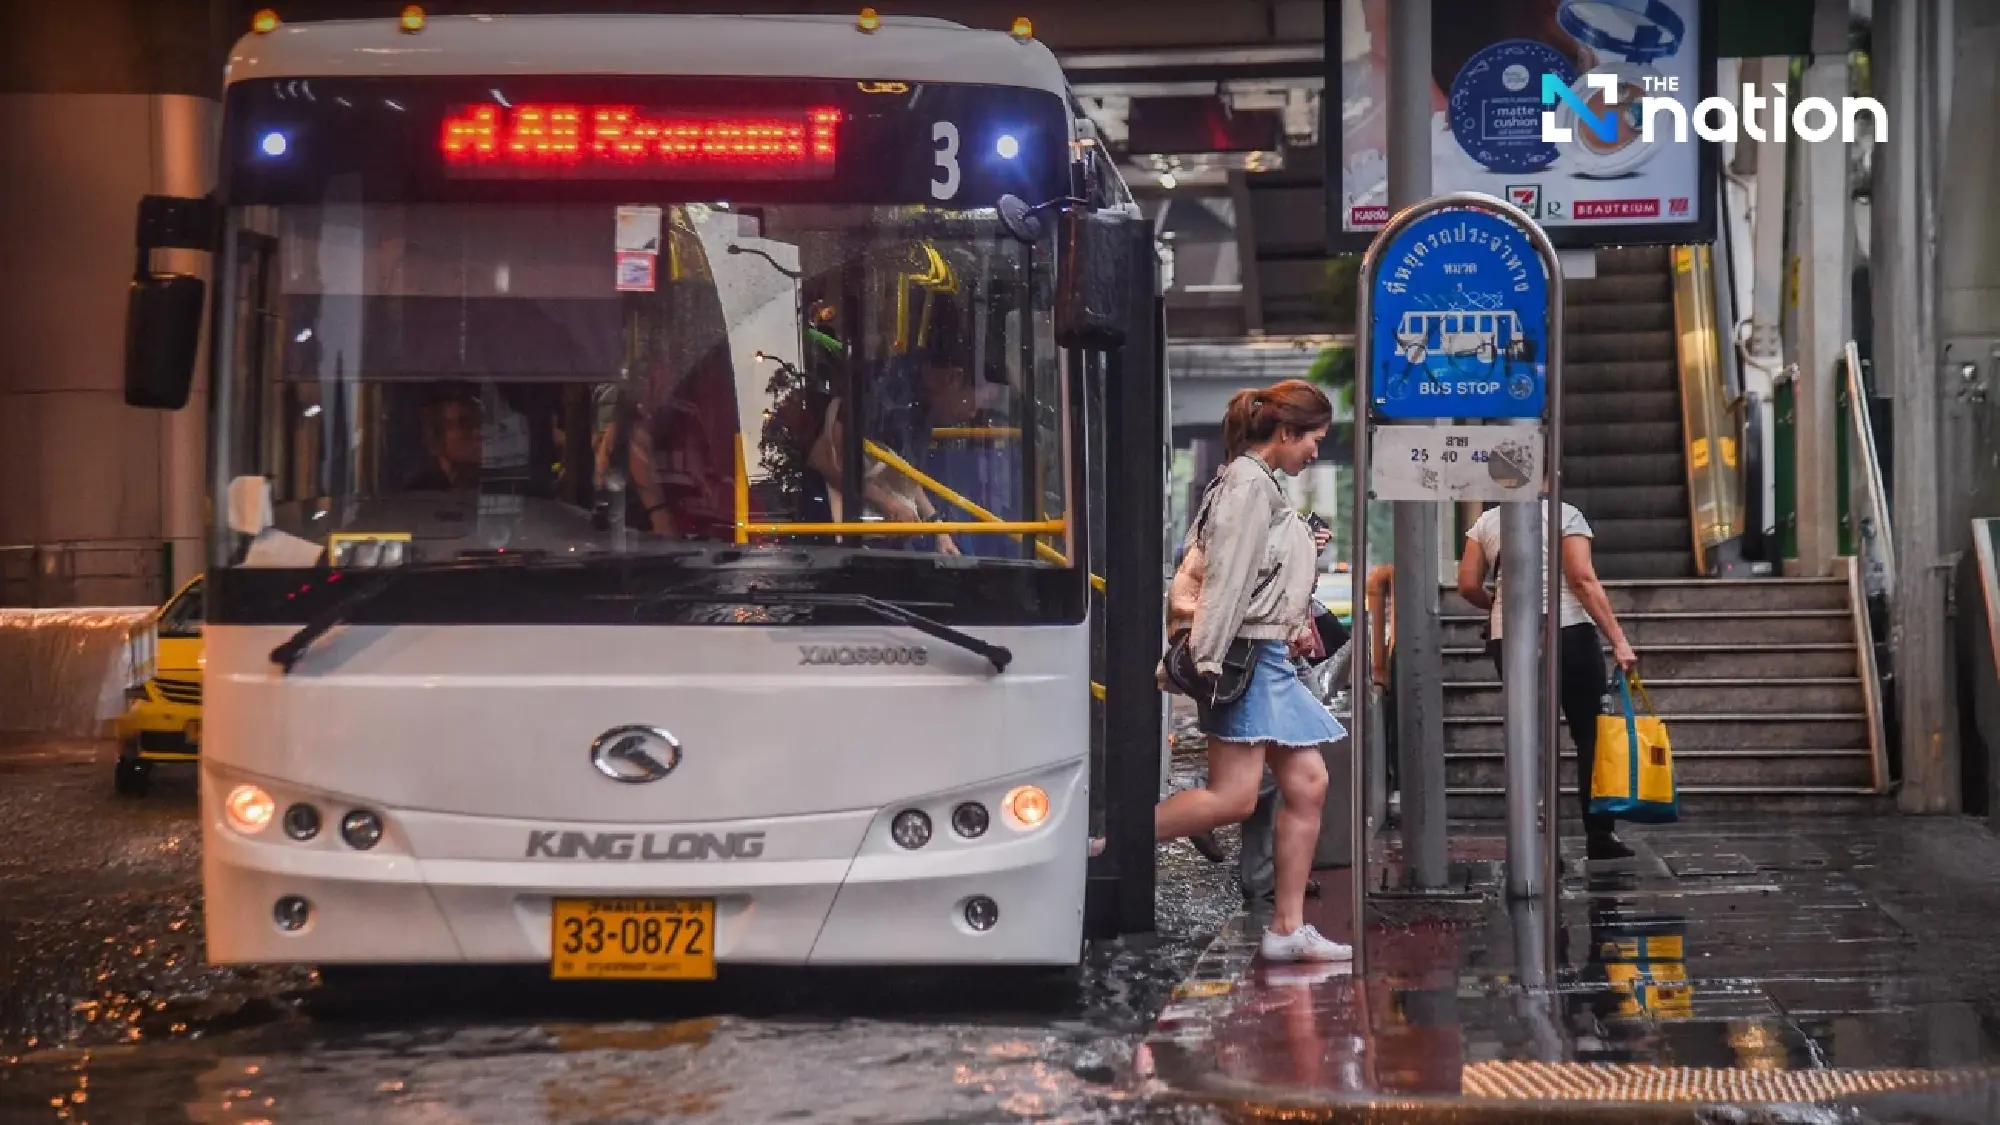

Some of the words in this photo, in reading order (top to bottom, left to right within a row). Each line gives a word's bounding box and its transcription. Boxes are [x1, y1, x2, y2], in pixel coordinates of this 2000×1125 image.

[1496, 105, 1536, 117] matte
[1493, 116, 1539, 129] cushion
[930, 121, 961, 201] 3
[1576, 203, 1656, 216] BEAUTRIUM
[1419, 382, 1452, 395] BUS
[1456, 382, 1501, 395] STOP
[1411, 448, 1429, 463] 25
[1440, 450, 1458, 463] 40
[525, 830, 636, 860] KING
[641, 832, 766, 860] LONG
[562, 916, 706, 955] 33-0872
